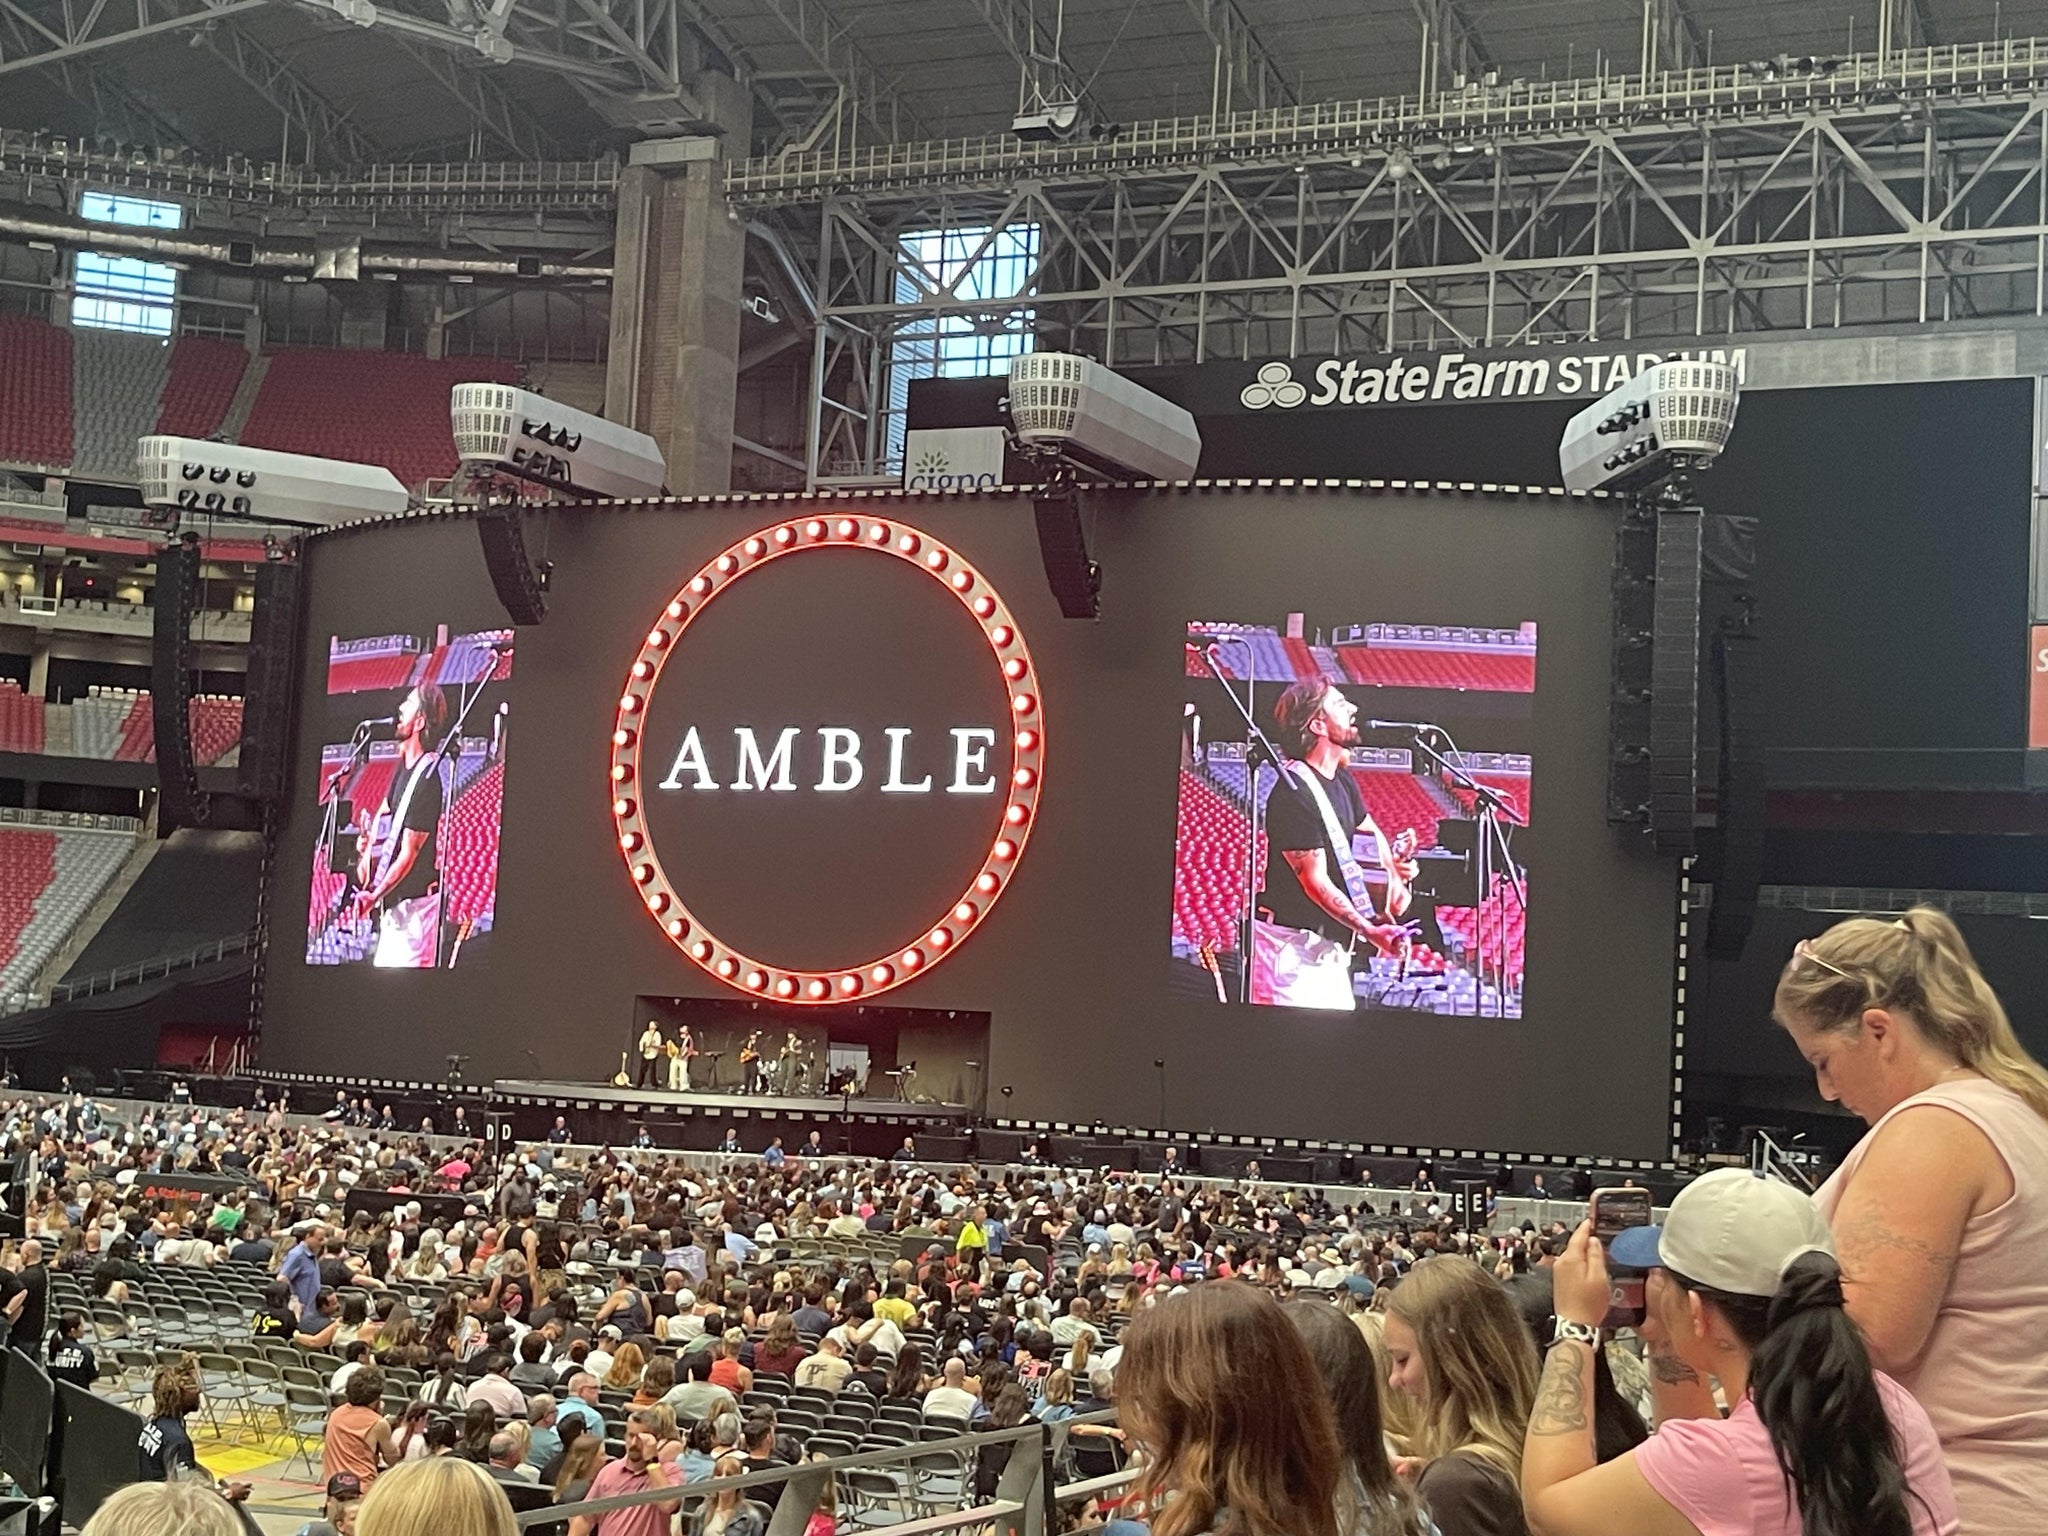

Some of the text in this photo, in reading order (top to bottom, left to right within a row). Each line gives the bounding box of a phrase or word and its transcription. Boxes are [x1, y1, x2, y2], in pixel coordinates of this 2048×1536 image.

[658, 726, 998, 794] AMBLE
[486, 1123, 512, 1141] D D
[1455, 1193, 1483, 1212] E E
